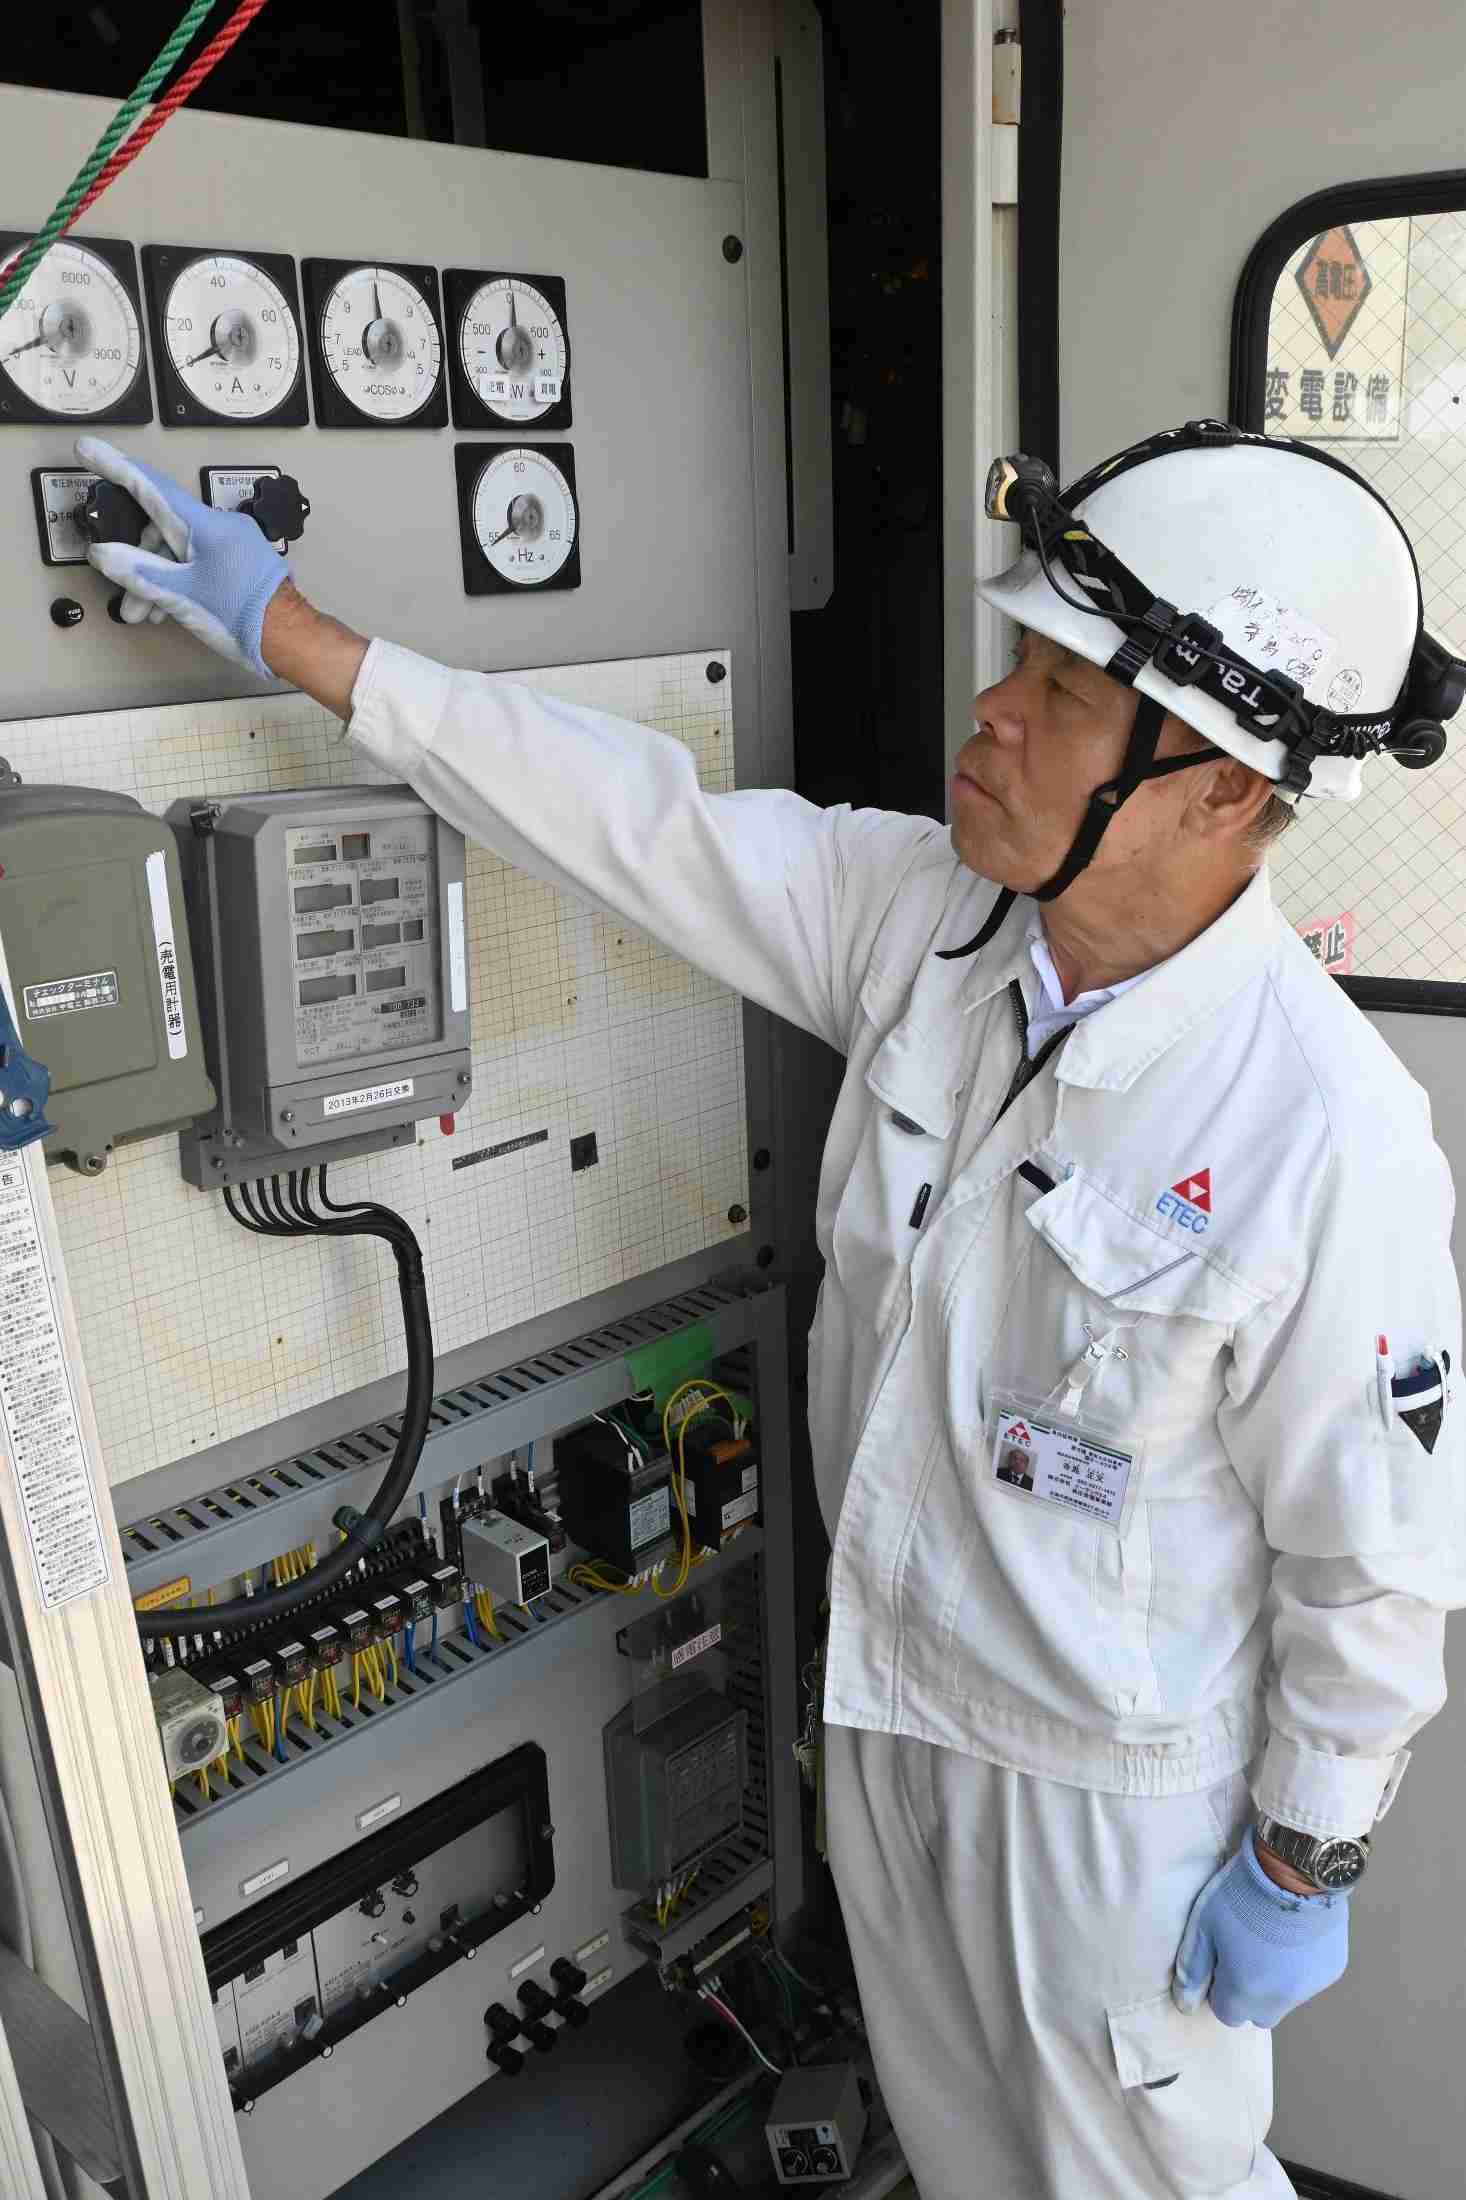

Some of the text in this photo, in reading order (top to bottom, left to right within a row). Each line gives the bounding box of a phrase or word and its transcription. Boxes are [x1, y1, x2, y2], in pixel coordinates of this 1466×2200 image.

[210, 275, 226, 288] 40
[261, 309, 277, 322] 60
[176, 317, 193, 331] 20
[268, 357, 282, 370] 75
[63, 369, 76, 388] V
[231, 377, 245, 394] A
[517, 547, 534, 562] Hz
[1156, 1191, 1208, 1233] ETEC
